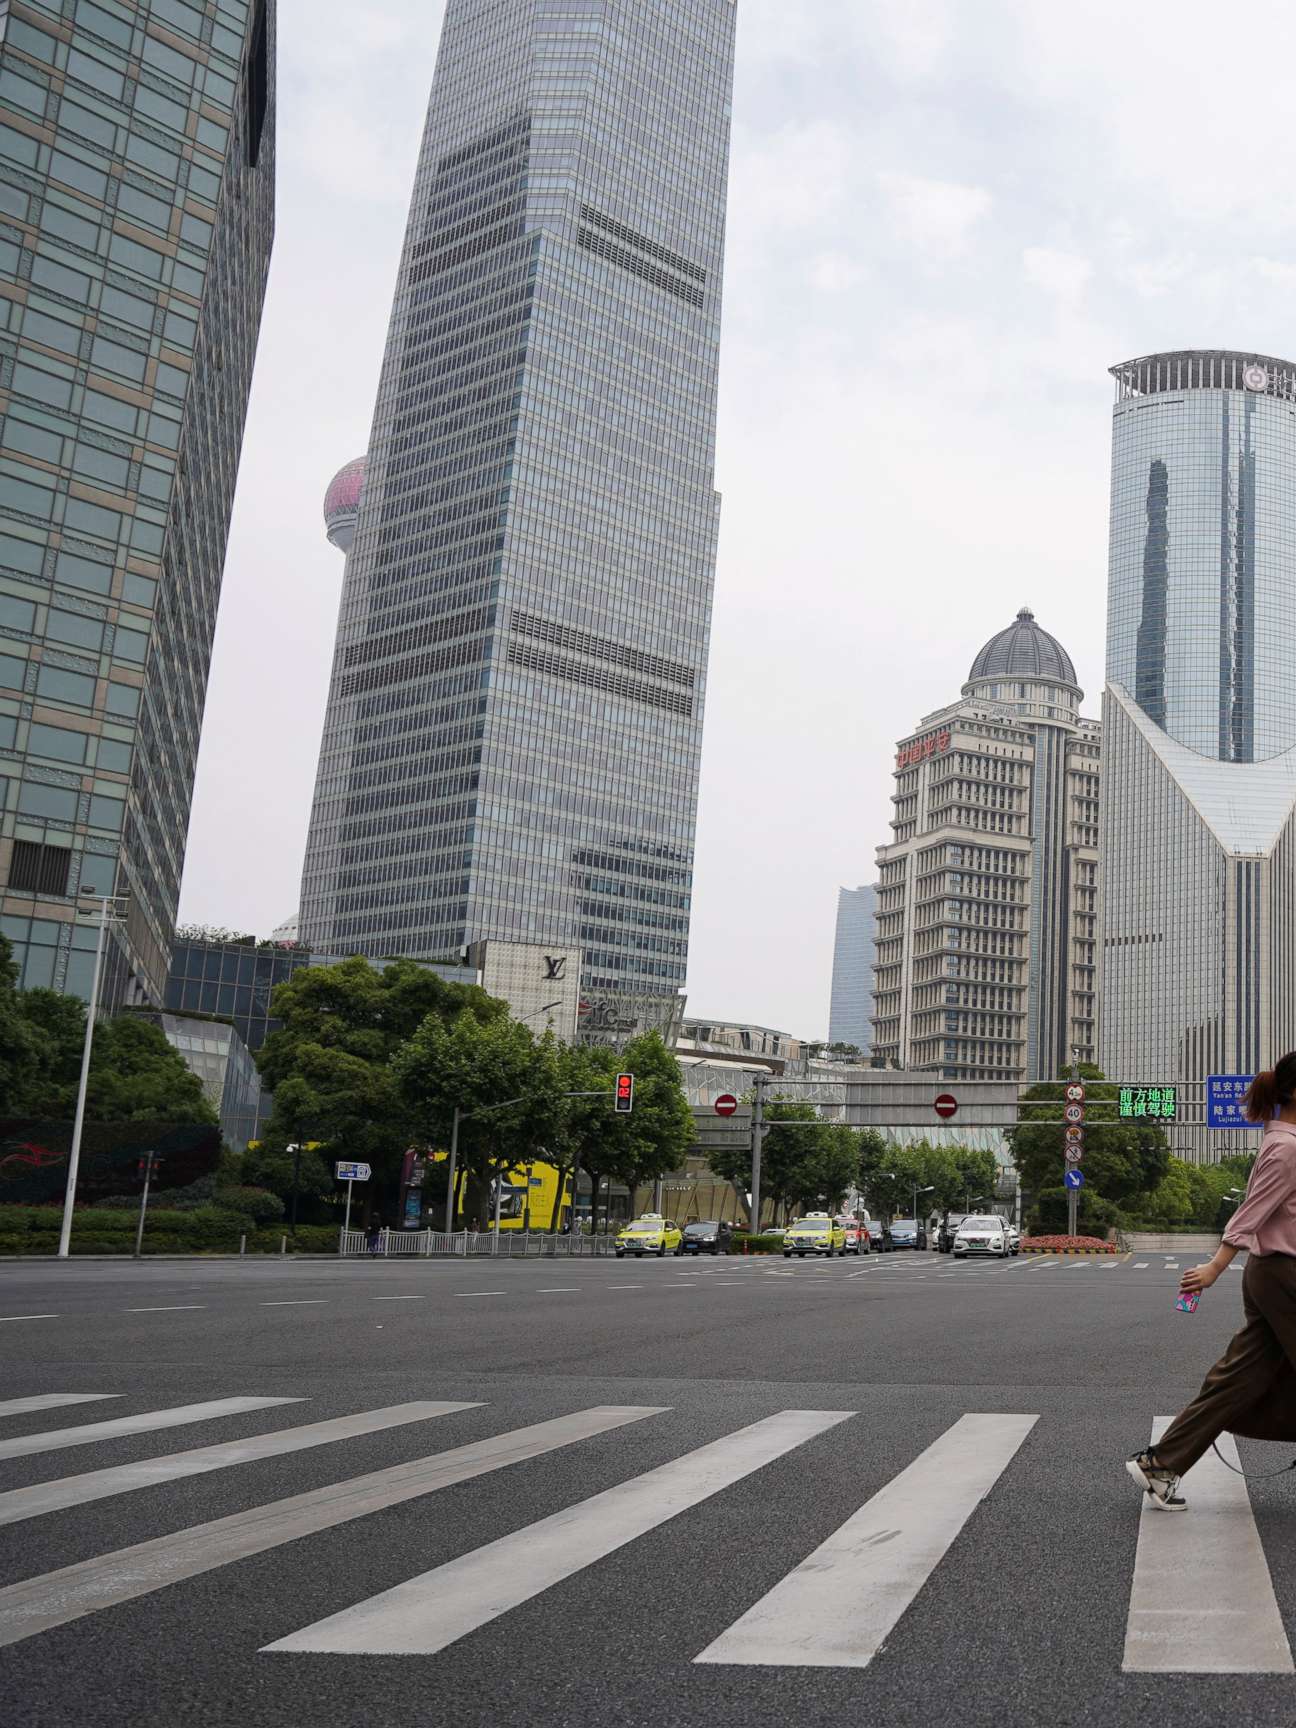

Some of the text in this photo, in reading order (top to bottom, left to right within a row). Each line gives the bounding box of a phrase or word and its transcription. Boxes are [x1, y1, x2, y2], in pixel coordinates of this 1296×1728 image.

[541, 955, 567, 979] LV
[1120, 1088, 1175, 1102] 前方地道
[1068, 1109, 1079, 1118] 40
[1120, 1102, 1175, 1117] 谨慎驾驶
